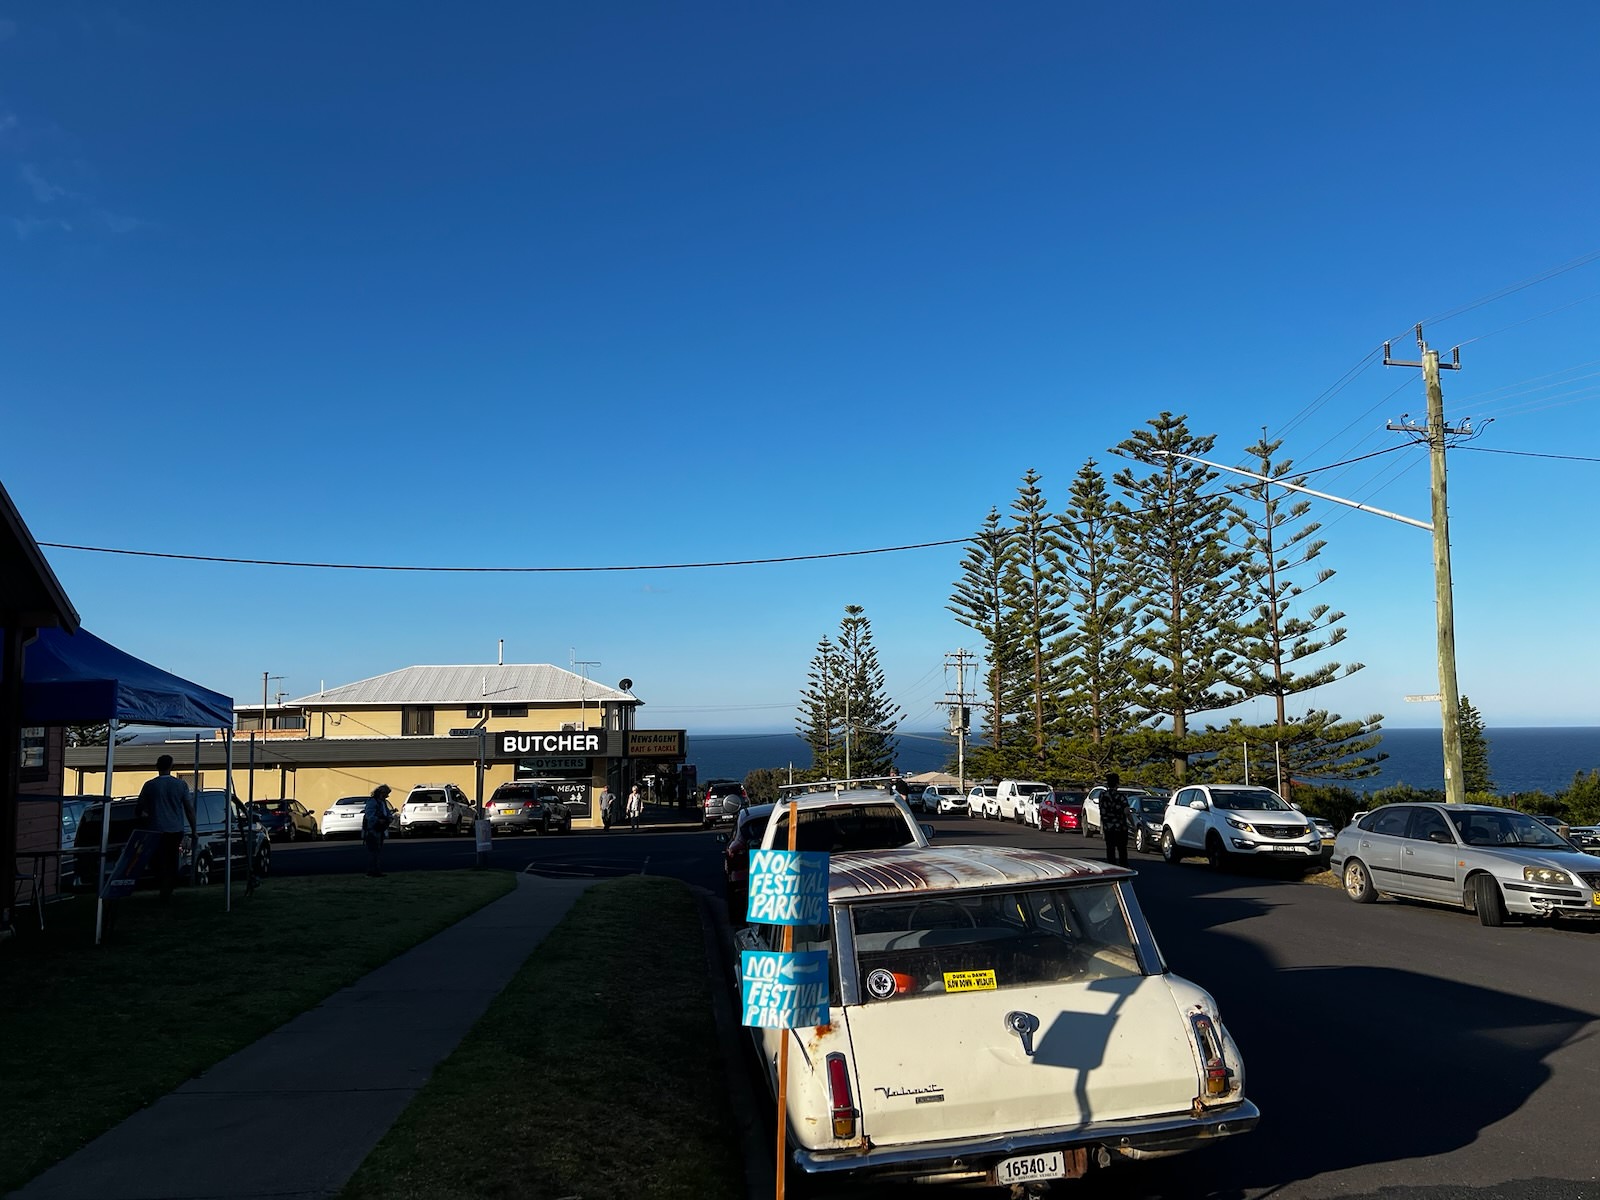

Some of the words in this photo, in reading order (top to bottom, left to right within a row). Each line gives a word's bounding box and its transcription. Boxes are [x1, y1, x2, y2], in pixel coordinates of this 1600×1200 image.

[503, 735, 599, 752] BUTCHER
[536, 759, 584, 768] OYSTERS
[749, 851, 792, 875] NO!
[750, 872, 825, 897] FESTIVAL
[750, 894, 823, 925] PARKING
[745, 955, 784, 984] NO!
[959, 979, 972, 987] DOWN
[747, 982, 829, 1010] FESTIVAL
[744, 1005, 821, 1029] PARKING
[1006, 1158, 1045, 1177] 16540
[1048, 1156, 1057, 1172] J
